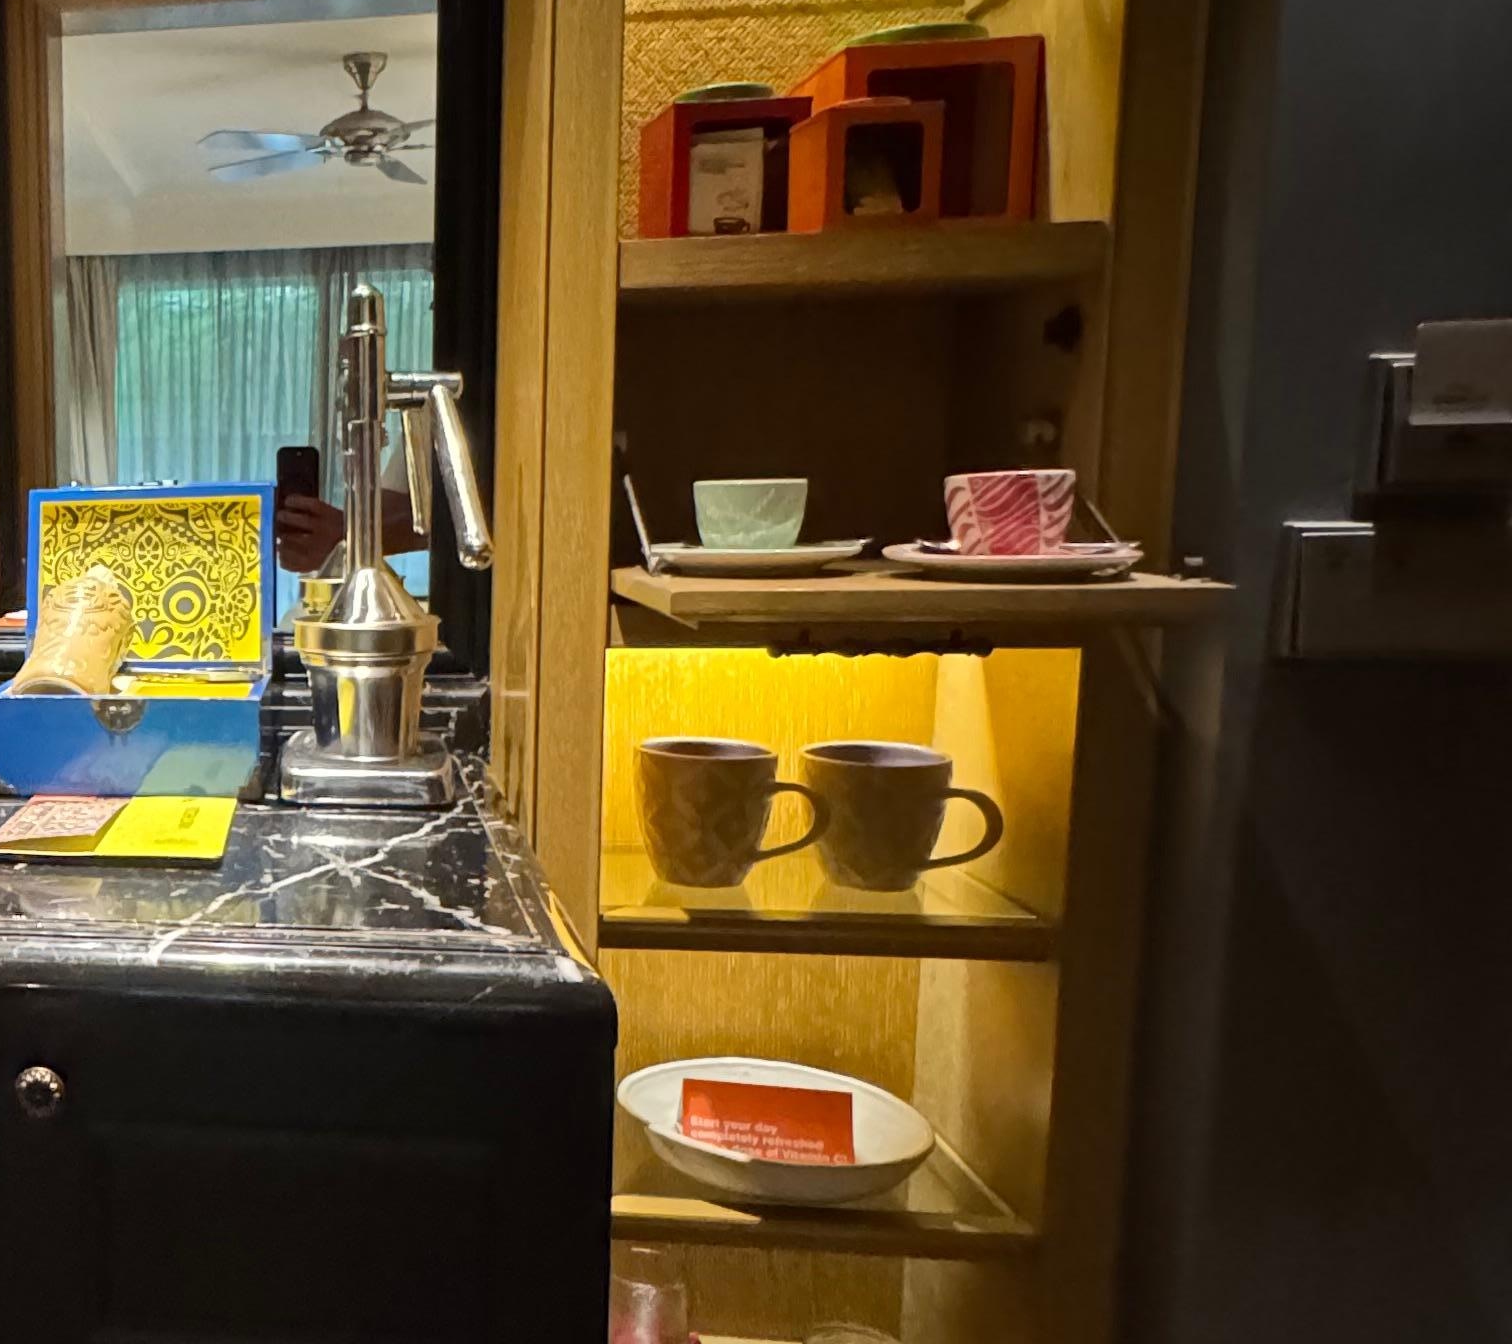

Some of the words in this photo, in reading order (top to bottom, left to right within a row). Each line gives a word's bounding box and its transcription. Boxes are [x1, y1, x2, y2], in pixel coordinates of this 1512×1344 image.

[690, 1115, 719, 1128] Start
[723, 1120, 751, 1134] your
[754, 1121, 777, 1135] day
[690, 1129, 759, 1145] completely
[762, 1135, 824, 1150] refreshed
